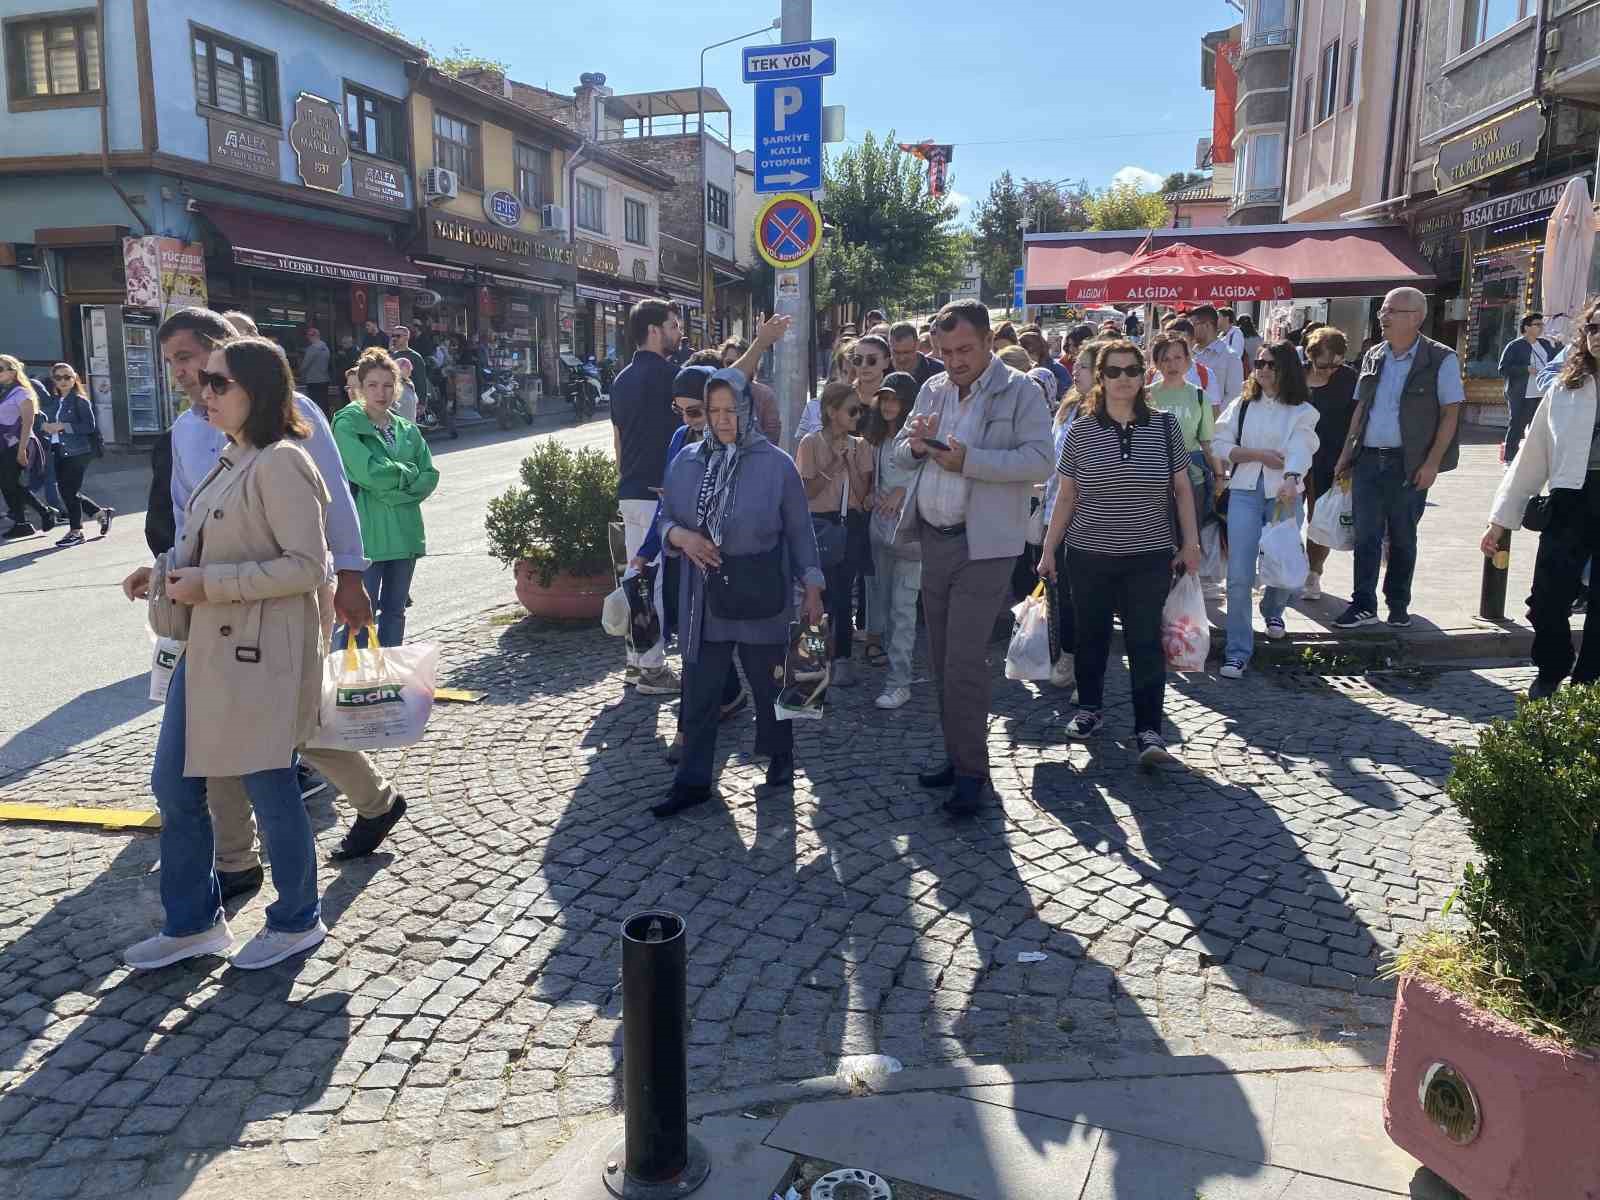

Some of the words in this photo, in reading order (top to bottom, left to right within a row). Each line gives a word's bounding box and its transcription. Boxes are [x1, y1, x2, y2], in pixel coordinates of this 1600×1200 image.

[752, 58, 778, 71] TEK
[784, 54, 811, 68] YÖN
[774, 87, 803, 132] P
[762, 133, 810, 146] ŞARKİYE
[770, 146, 802, 156] KATLI
[1472, 127, 1500, 151] BAŞAK
[761, 157, 811, 168] OTOPARK
[1466, 153, 1486, 175] PİLİÇ
[1486, 140, 1521, 167] MARKET
[1463, 205, 1494, 228] BAŞAK
[1497, 201, 1511, 218] ET
[1510, 191, 1537, 214] PİLİÇ
[434, 220, 471, 244] TARİHİ
